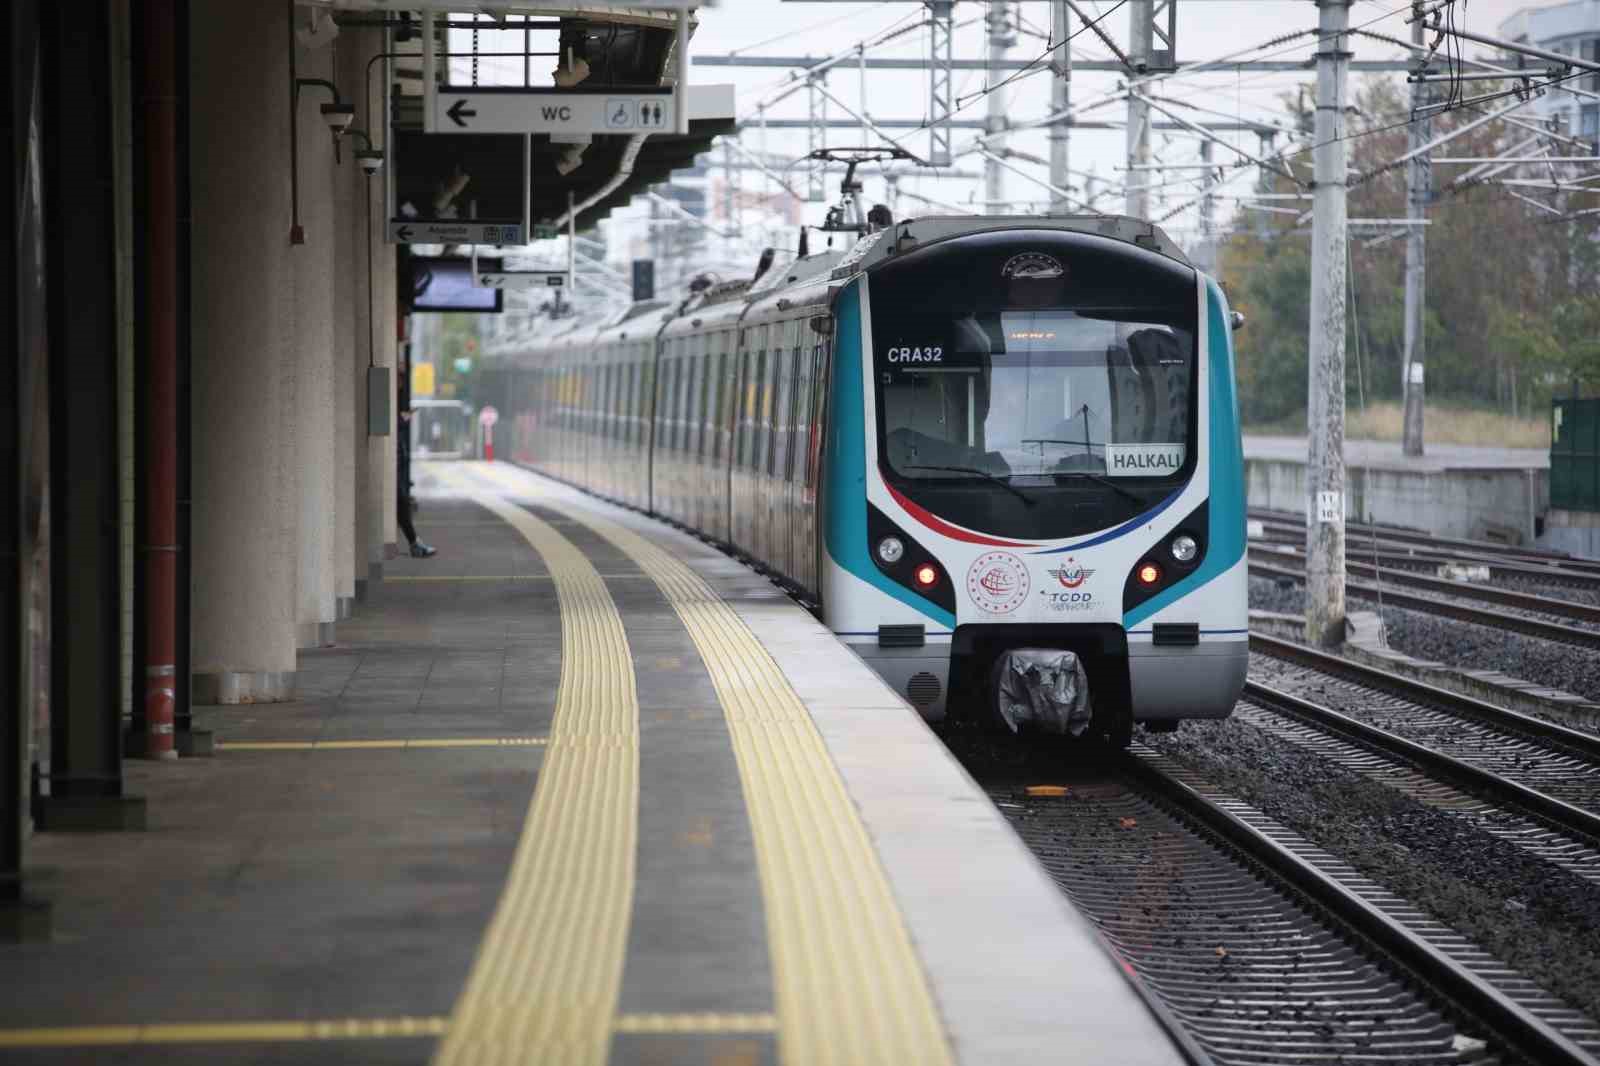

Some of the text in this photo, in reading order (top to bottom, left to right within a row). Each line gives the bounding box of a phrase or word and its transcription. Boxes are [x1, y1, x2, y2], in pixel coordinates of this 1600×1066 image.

[541, 106, 571, 121] WC
[888, 347, 943, 362] CRA32
[1113, 453, 1180, 469] HALKALI
[1050, 592, 1092, 602] TCDD
